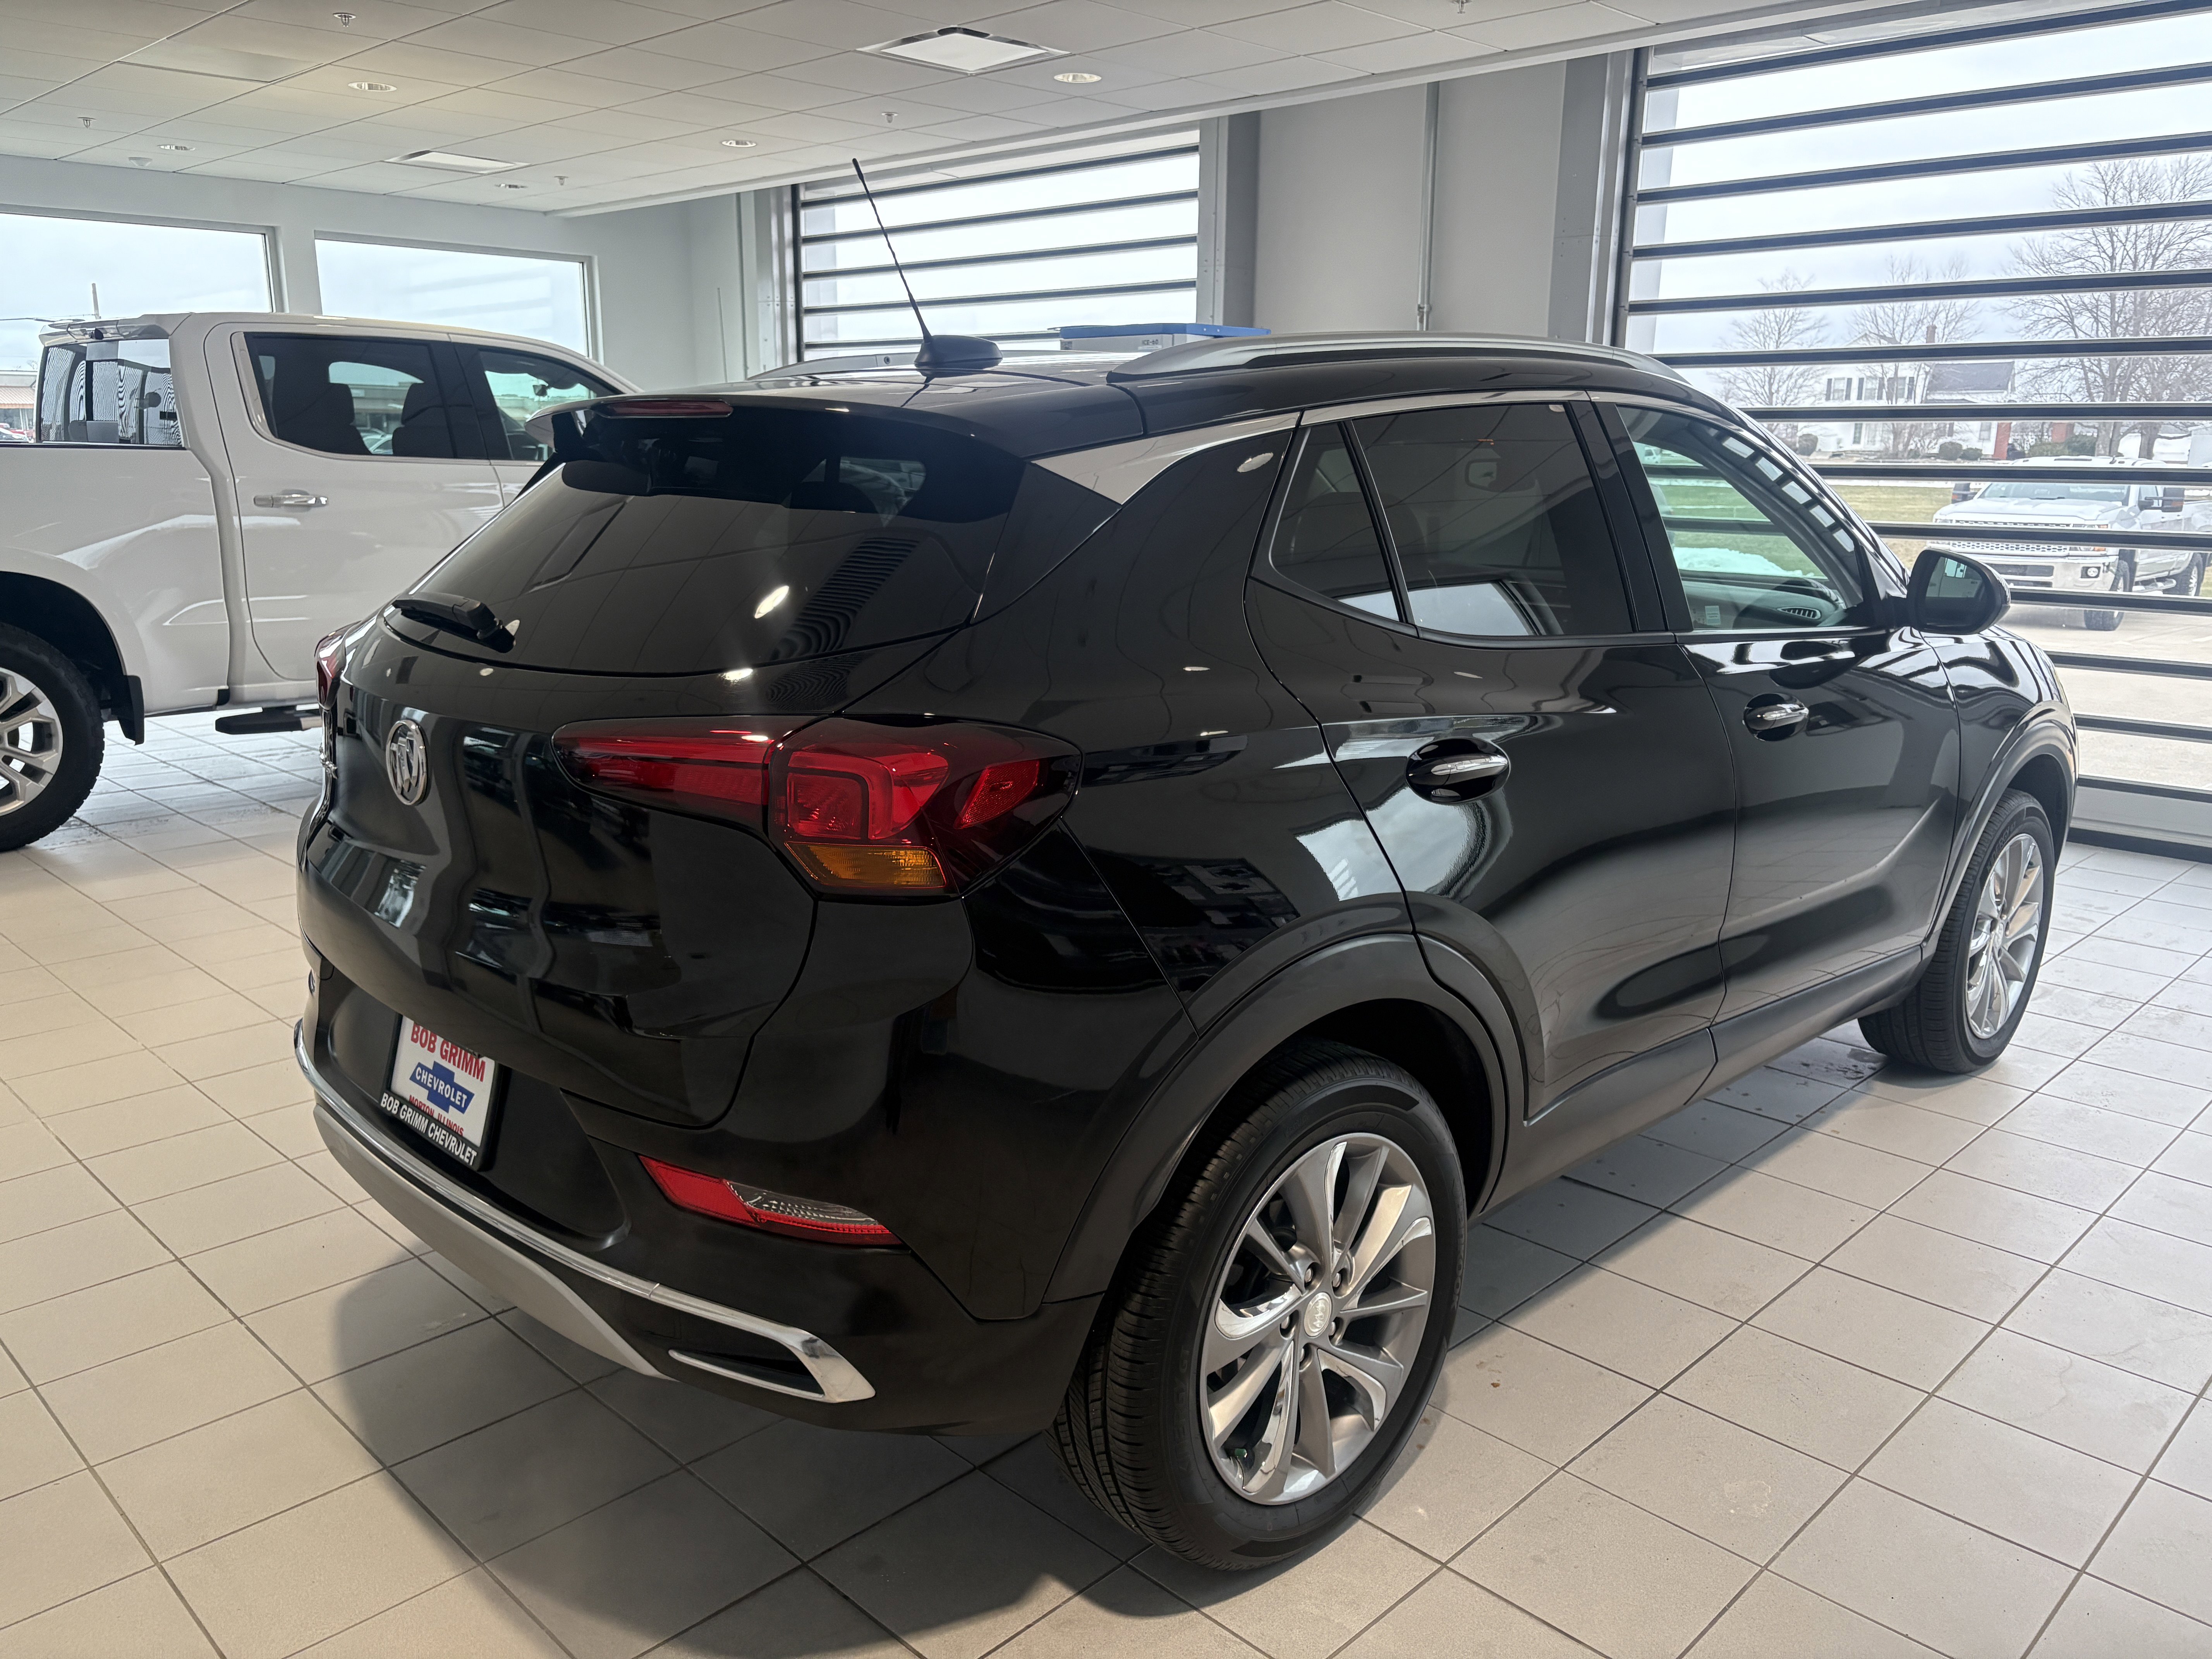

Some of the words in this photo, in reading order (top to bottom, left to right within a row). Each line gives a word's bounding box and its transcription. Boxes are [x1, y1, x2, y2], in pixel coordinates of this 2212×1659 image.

[411, 1022, 437, 1053] BOB
[440, 1039, 486, 1082] GRIMM
[416, 1066, 467, 1108] CHEVROLET
[381, 1092, 400, 1115] BOB
[400, 1104, 429, 1133] GRIMM
[428, 1122, 477, 1166] CHEVROLET
[438, 1113, 464, 1136] ILLINOIS
